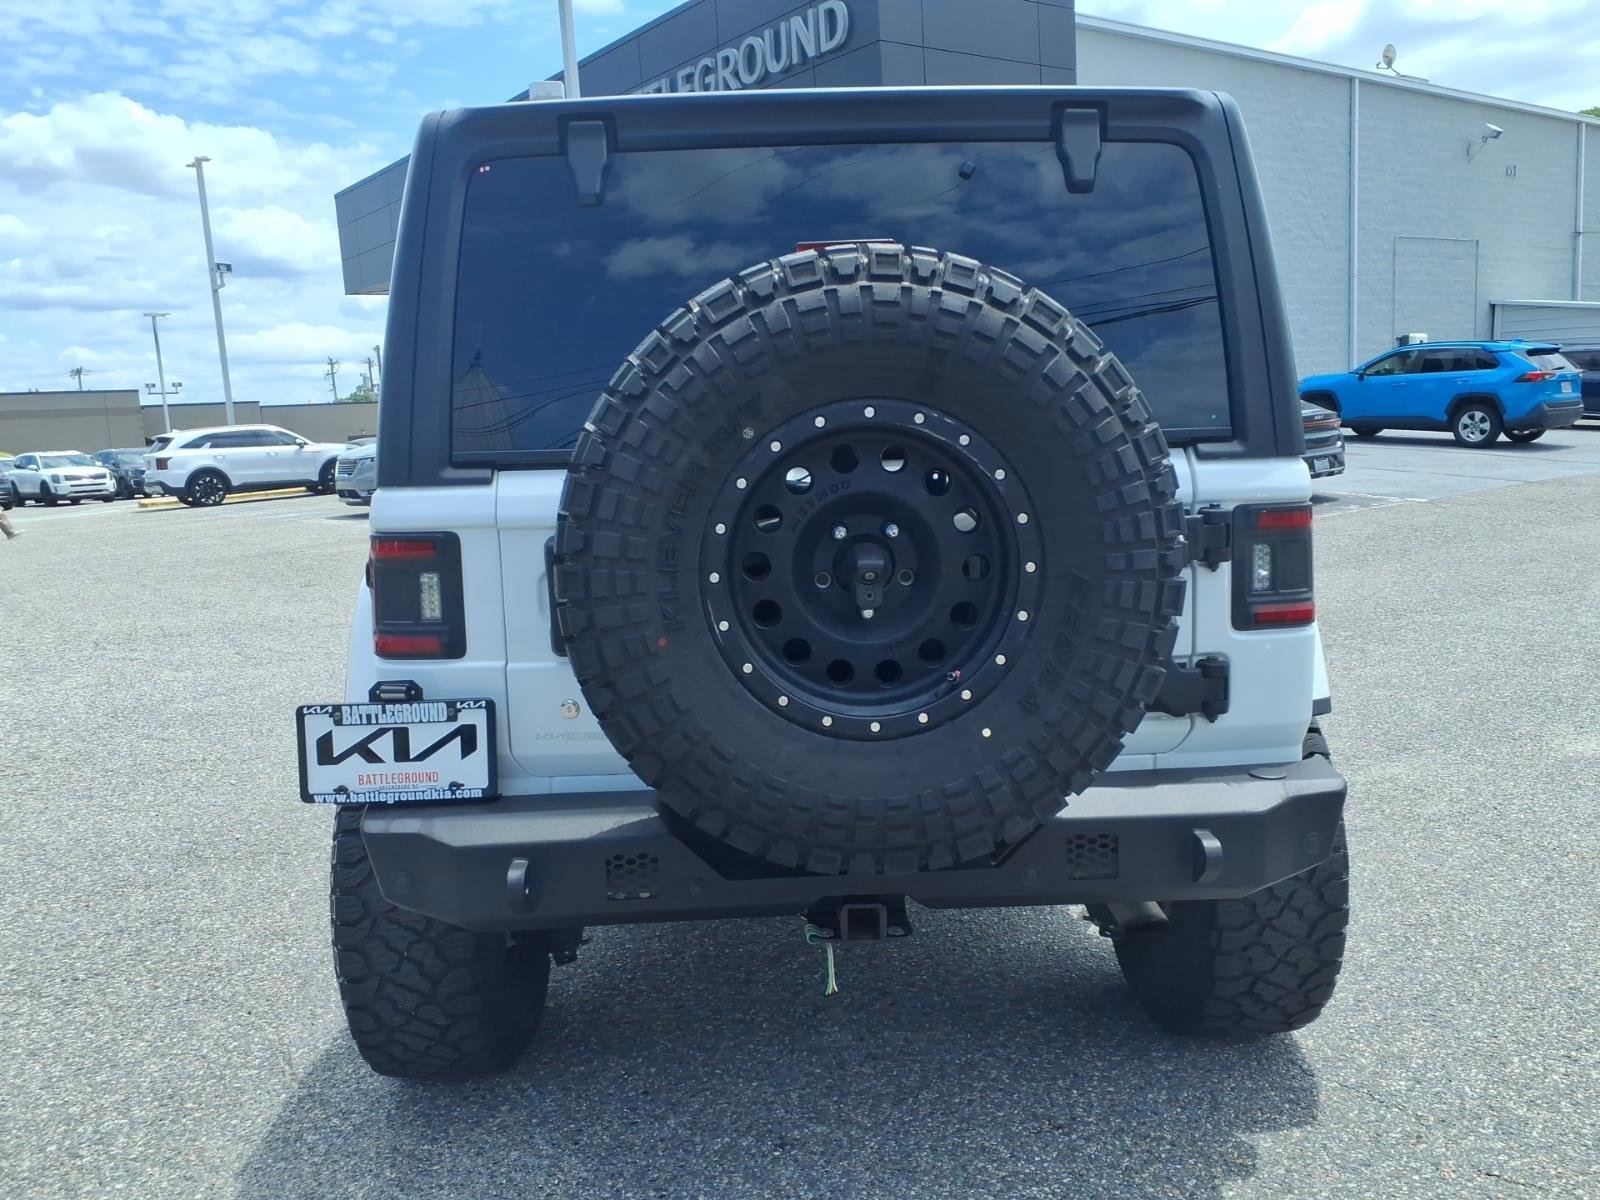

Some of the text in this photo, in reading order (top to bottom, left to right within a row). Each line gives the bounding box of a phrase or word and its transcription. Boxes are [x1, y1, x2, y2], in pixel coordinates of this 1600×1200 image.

[633, 0, 849, 95] EGROUND
[341, 702, 448, 725] BATTLEGROUND
[316, 724, 477, 766] KIA
[358, 771, 439, 785] BATTLEGROUND
[313, 788, 483, 804] www.battlegroundkia.com
